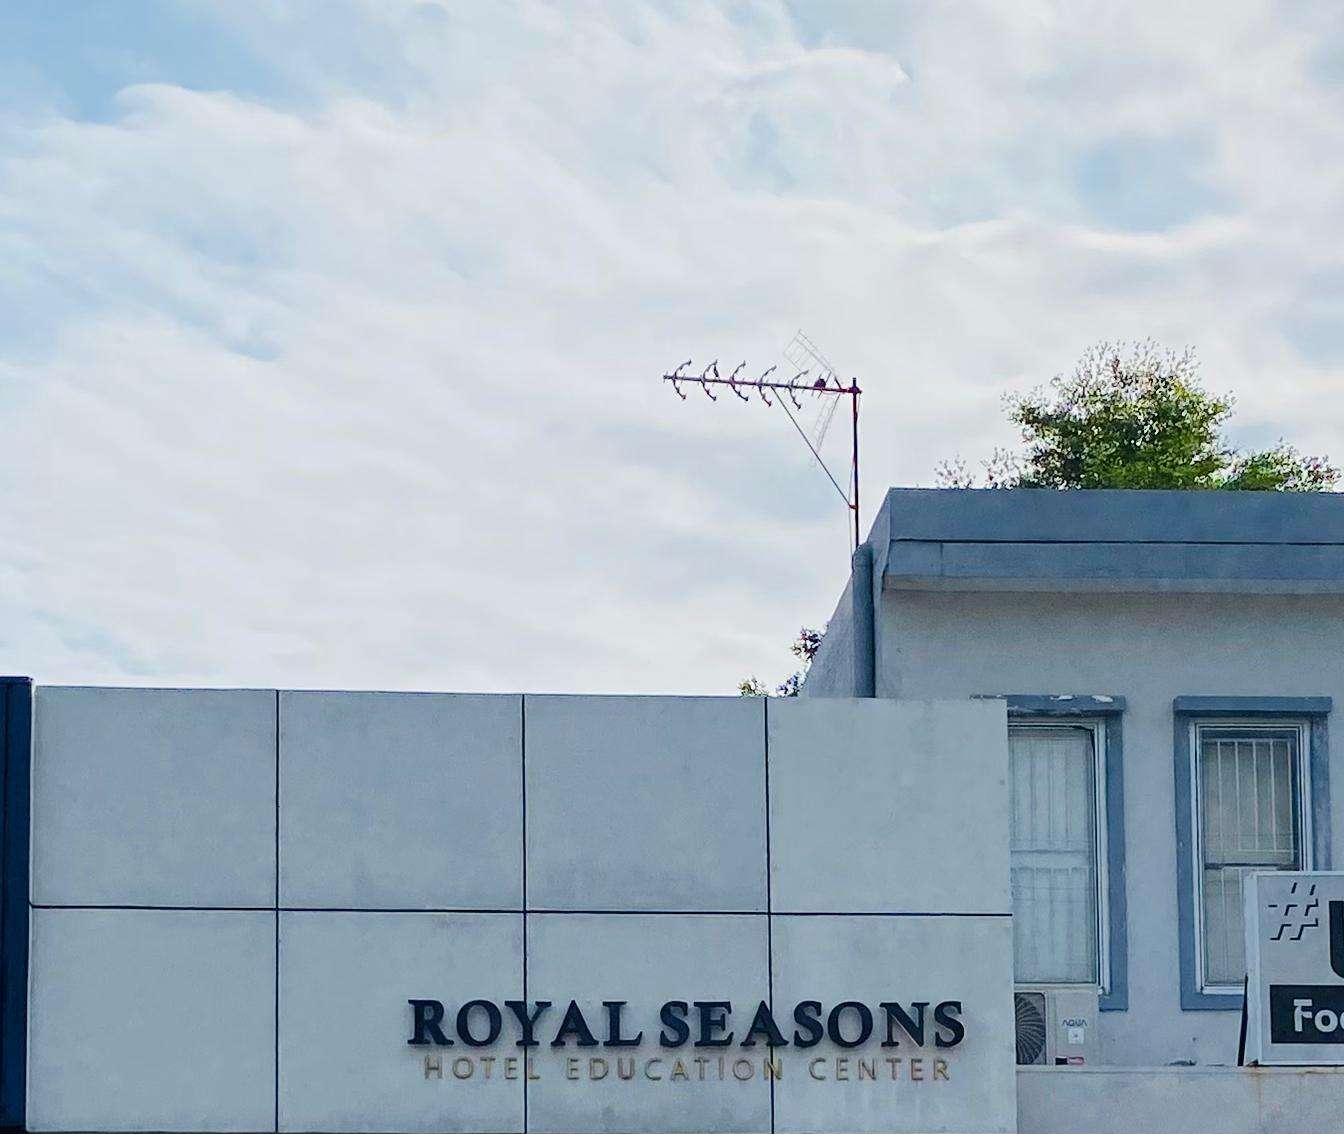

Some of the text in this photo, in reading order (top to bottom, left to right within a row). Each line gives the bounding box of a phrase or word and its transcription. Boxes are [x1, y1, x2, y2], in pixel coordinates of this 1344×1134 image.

[407, 999, 966, 1049] ROYAL SEASONS
[1062, 1018, 1087, 1027] AQUA
[424, 1056, 951, 1082] HOTEL EDUCATION CENTER
